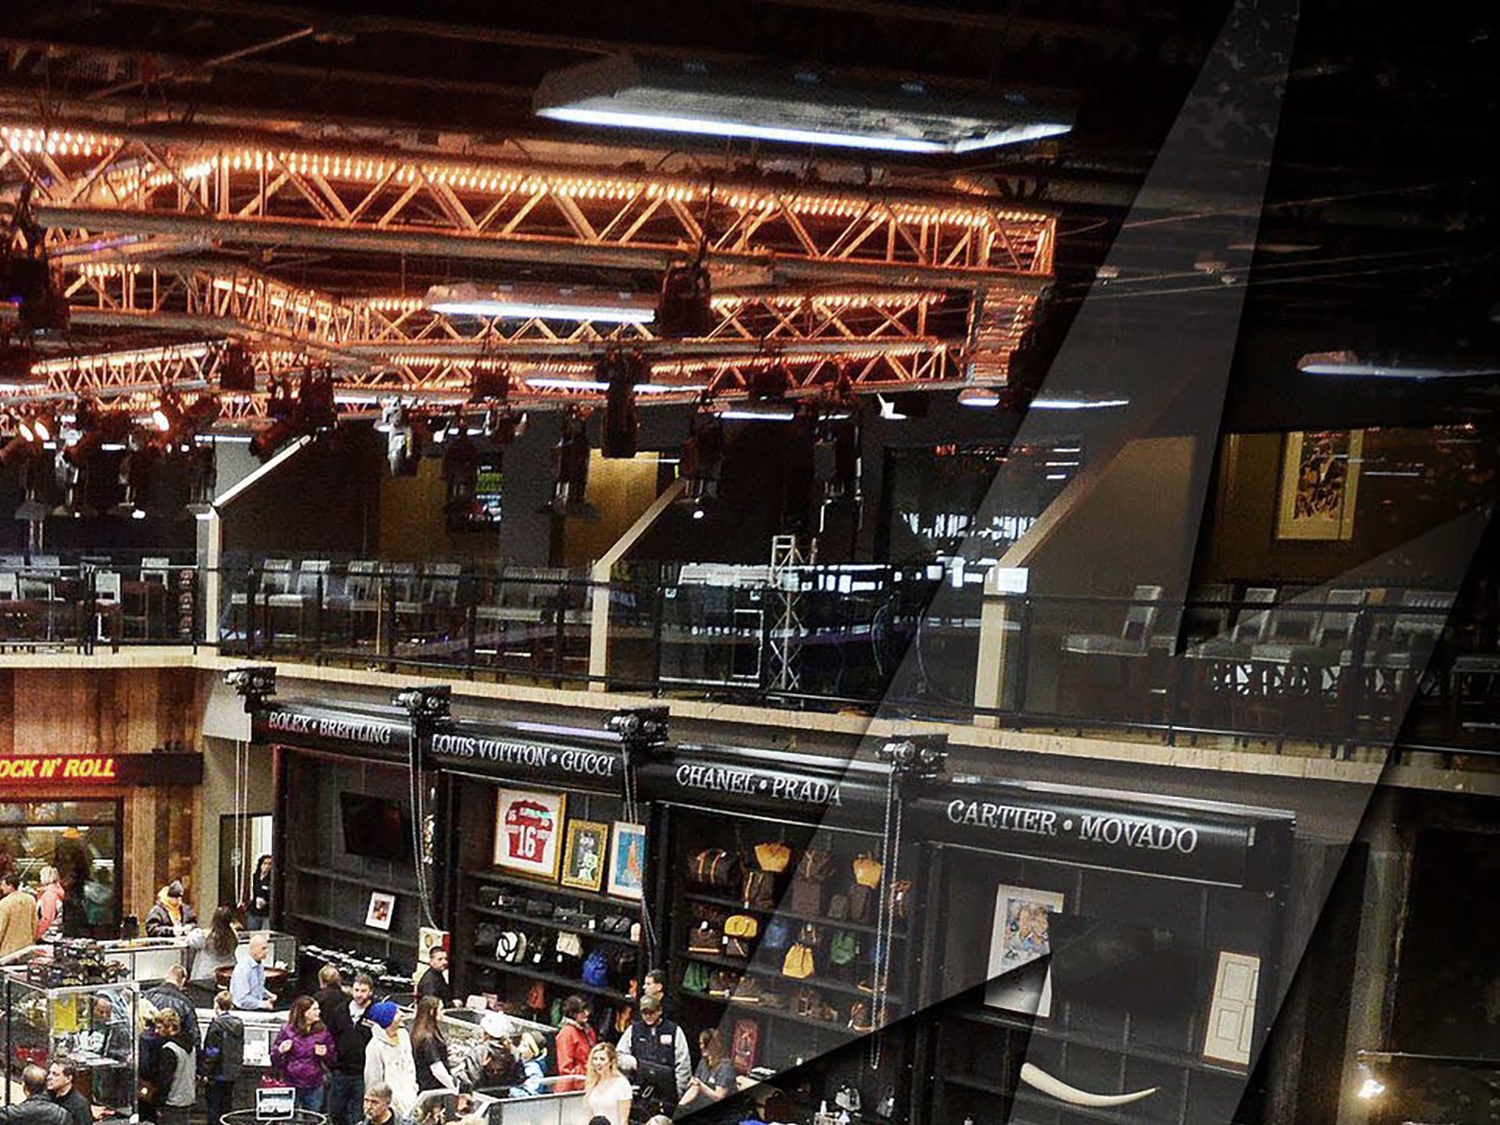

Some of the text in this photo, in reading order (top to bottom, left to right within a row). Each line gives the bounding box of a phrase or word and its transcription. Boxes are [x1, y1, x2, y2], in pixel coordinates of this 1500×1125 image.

[268, 712, 391, 744] ROLEX BREITLING
[63, 758, 115, 778] ROLL
[431, 734, 615, 777] LOUIS VUITTON GUCCI
[675, 764, 842, 806] CHANEL PRADA
[517, 824, 536, 858] 16
[947, 799, 1198, 854] CARTIER MOVADO
